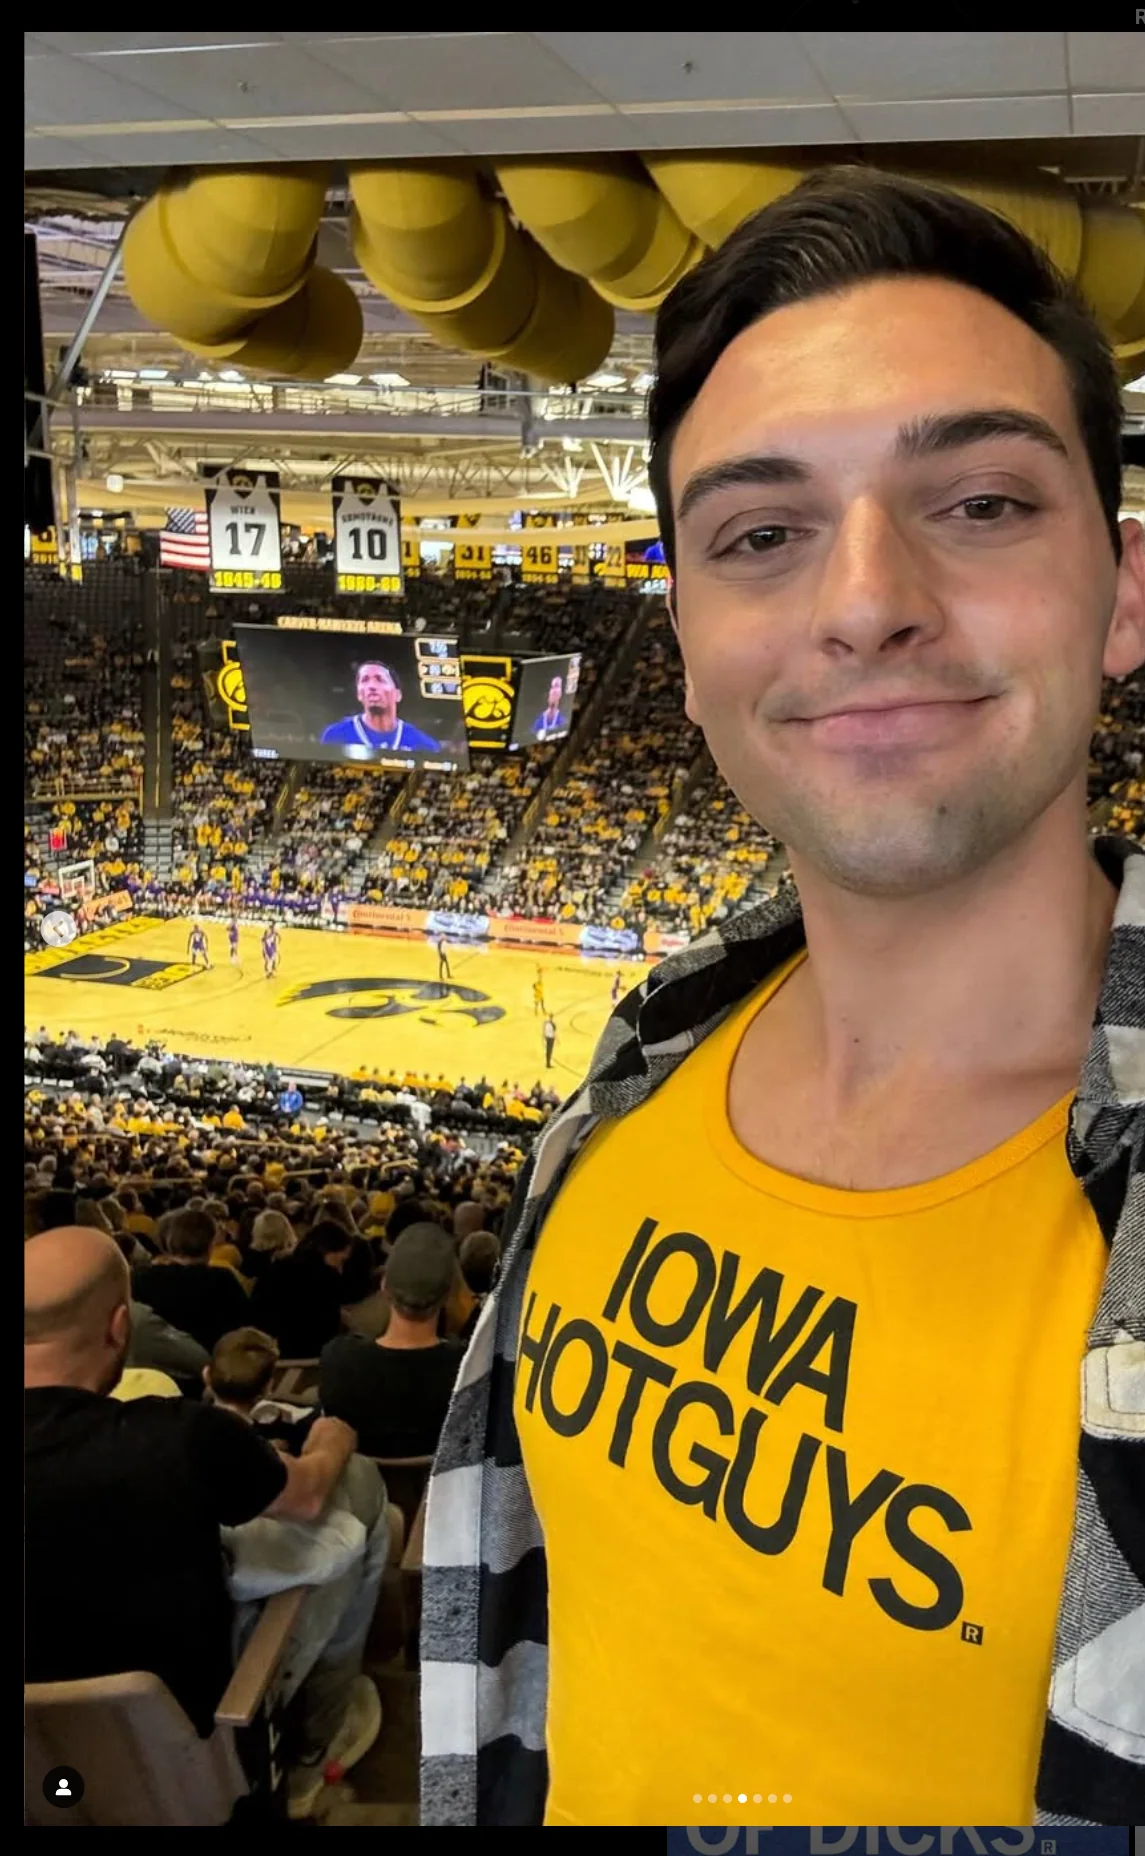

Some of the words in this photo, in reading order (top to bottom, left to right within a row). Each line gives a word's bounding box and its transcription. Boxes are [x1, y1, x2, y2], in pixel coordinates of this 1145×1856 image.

[225, 521, 266, 556] 17
[349, 527, 387, 560] 10
[526, 545, 552, 564] 46
[601, 1216, 858, 1434] IOWA
[518, 1291, 973, 1632] HOTGUYS
